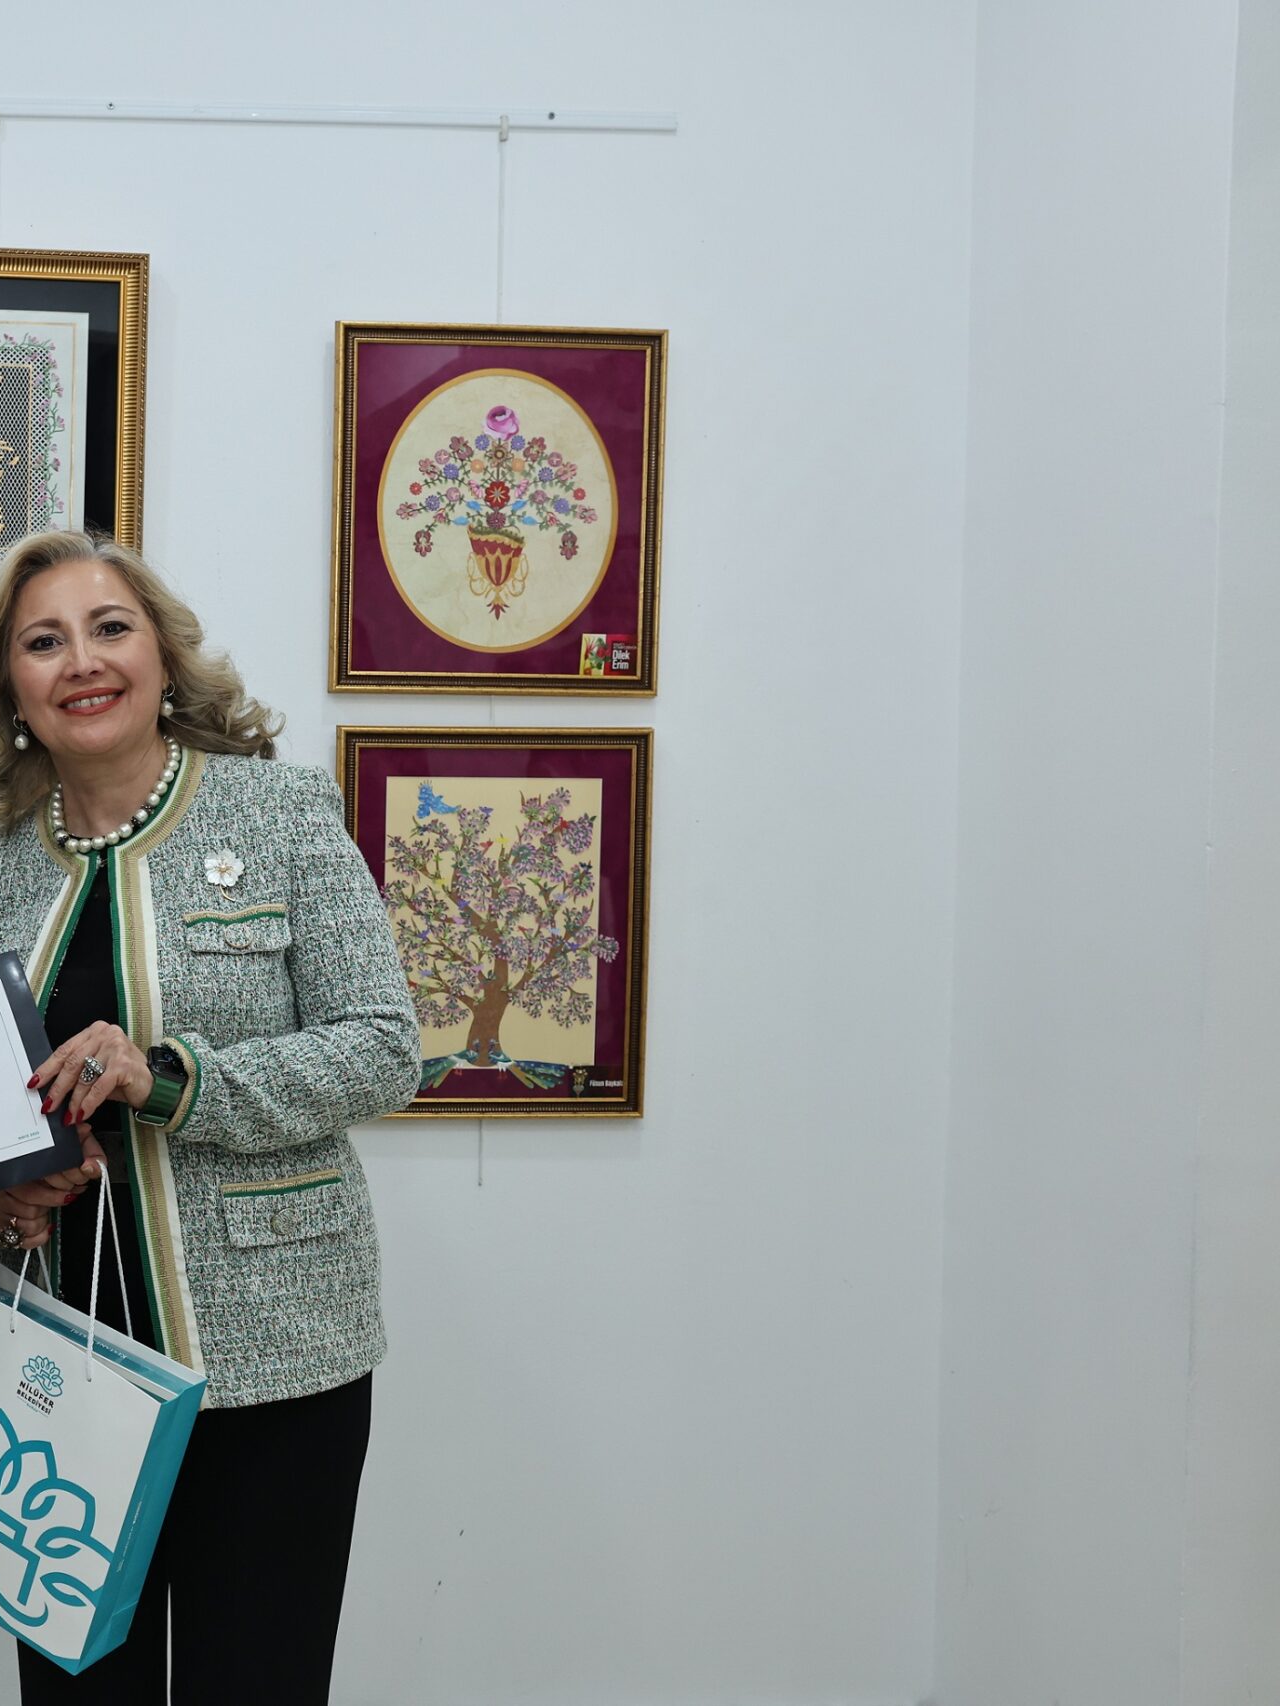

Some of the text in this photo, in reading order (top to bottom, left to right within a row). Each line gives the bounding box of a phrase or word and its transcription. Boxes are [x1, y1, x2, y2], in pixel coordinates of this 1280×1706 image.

[612, 650, 630, 660] Dilek
[612, 660, 629, 670] Erim
[16, 1388, 52, 1415] BELEDİYESİ
[20, 1381, 54, 1408] NİLÜFER
